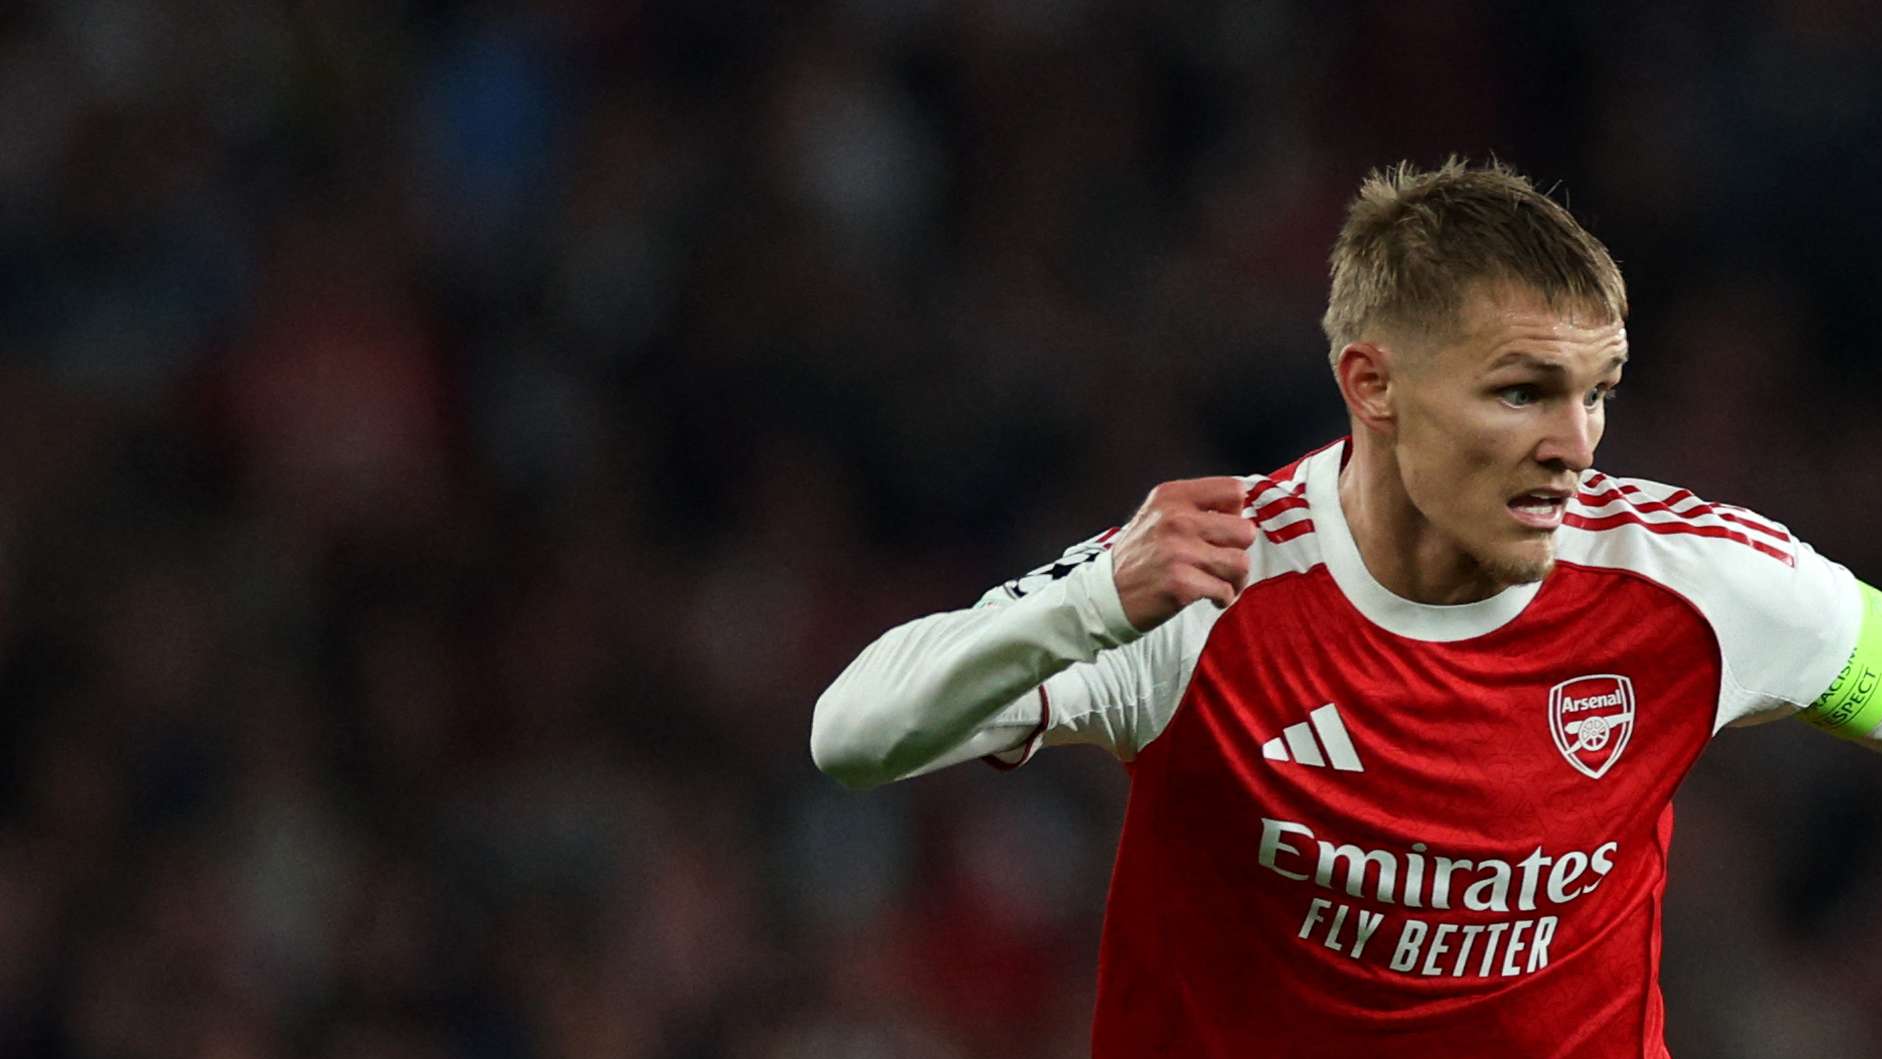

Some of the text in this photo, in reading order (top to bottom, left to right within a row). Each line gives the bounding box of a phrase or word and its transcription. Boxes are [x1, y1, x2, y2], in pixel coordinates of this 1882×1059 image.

[1562, 689, 1622, 713] Arsenal
[1258, 817, 1618, 912] Emirates
[1299, 897, 1558, 977] FLY BETTER
